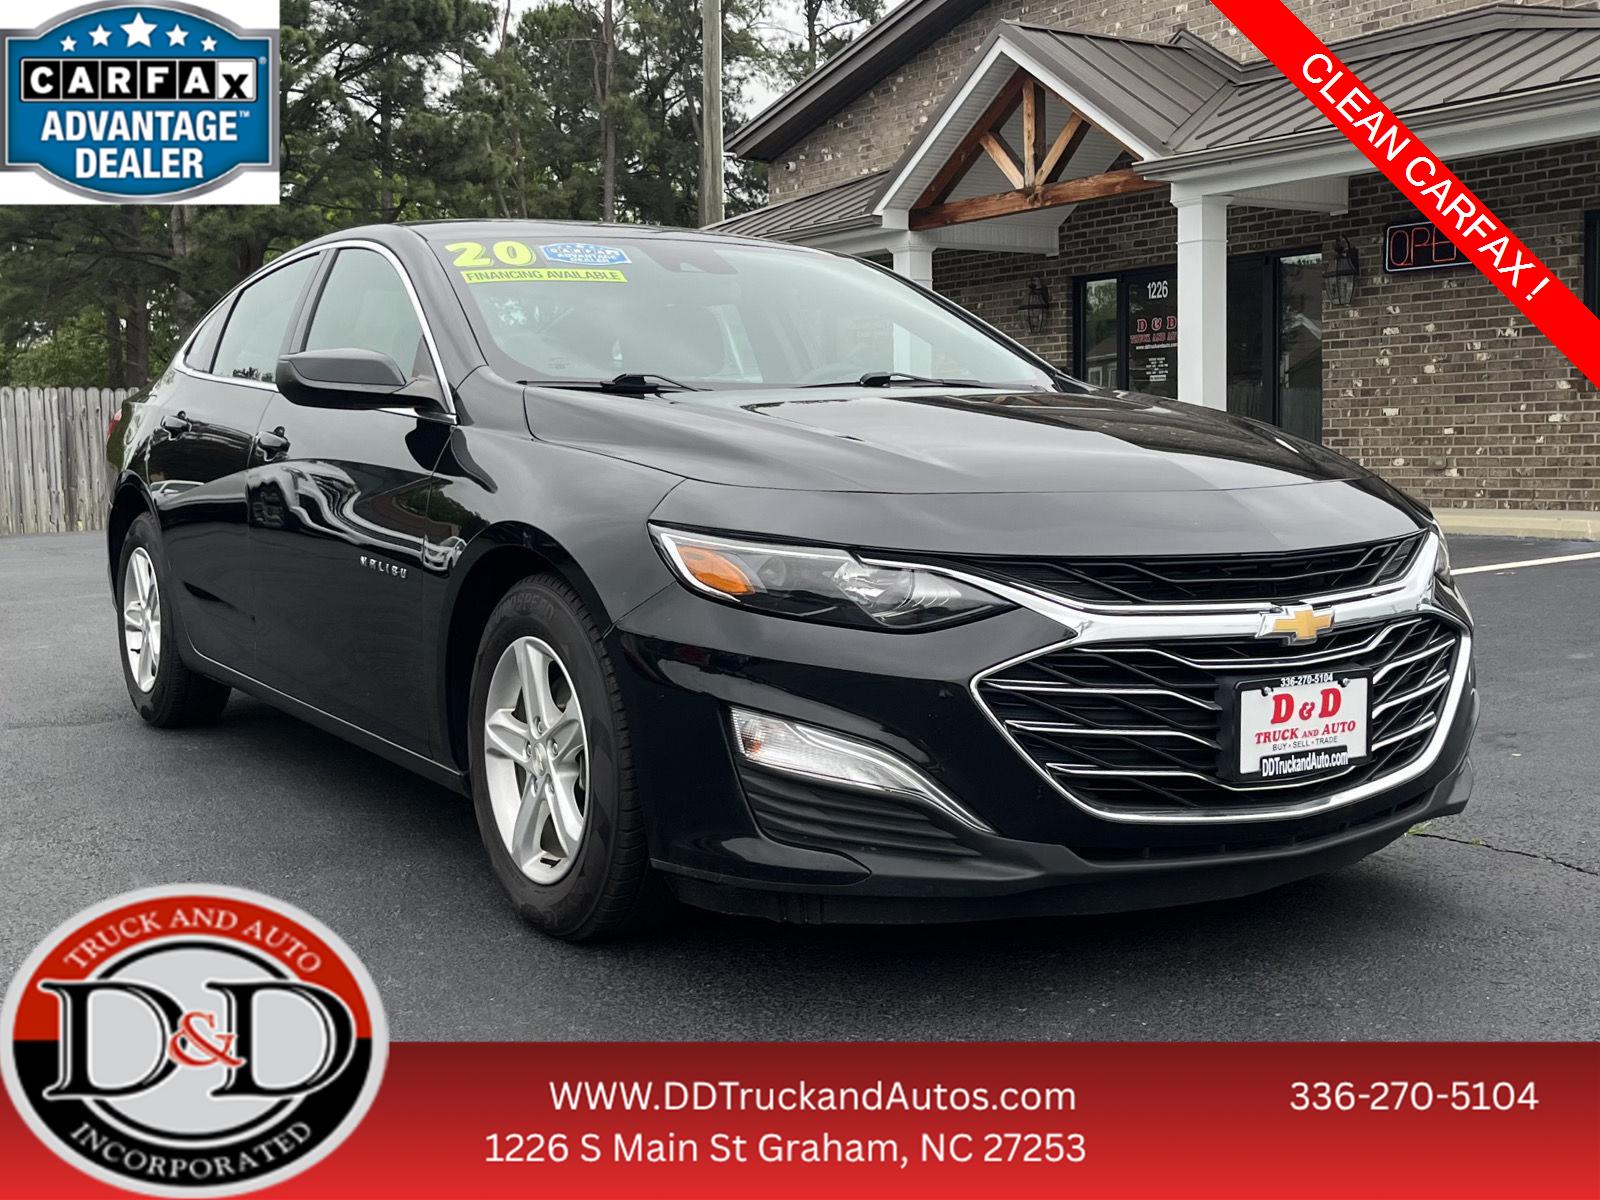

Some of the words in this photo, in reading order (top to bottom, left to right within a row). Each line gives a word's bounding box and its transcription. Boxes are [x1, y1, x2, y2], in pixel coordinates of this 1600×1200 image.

[446, 241, 537, 267] 20
[1390, 227, 1458, 267] OPE
[465, 270, 544, 282] FINANCING
[546, 270, 622, 281] AVAILABLE
[1147, 280, 1168, 299] 1226
[1137, 319, 1147, 332] D
[1166, 316, 1177, 329] D
[360, 556, 407, 578] MALIBU
[1280, 673, 1334, 687] 336-270-5104
[1270, 693, 1294, 724] D
[1299, 702, 1315, 721] &
[1318, 688, 1342, 718] D
[1254, 728, 1299, 744] TRUCK
[1302, 729, 1319, 738] AND
[1322, 720, 1356, 736] AUTO
[1272, 743, 1287, 751] BUY
[1293, 740, 1311, 749] SELL
[1315, 736, 1338, 745] TRADE
[1262, 751, 1349, 777] DDTruckandAuto.com
